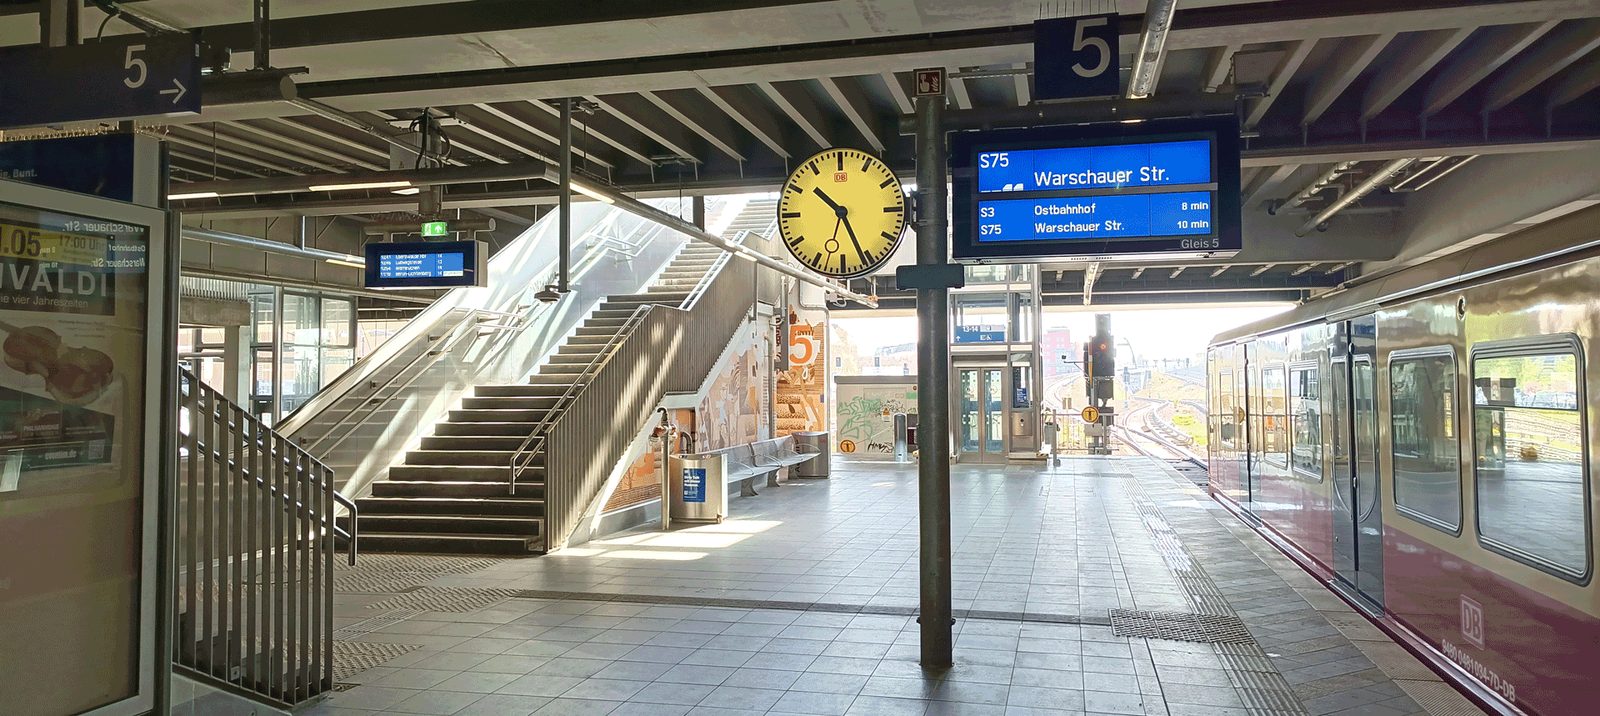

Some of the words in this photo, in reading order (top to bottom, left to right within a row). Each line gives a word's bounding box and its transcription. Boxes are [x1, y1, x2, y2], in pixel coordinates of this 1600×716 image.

[1071, 17, 1111, 78] 5
[123, 44, 148, 89] 5
[979, 152, 1010, 169] S75
[1034, 169, 1134, 187] Warschauer
[1139, 166, 1170, 183] Str.
[980, 207, 995, 218] S3
[1034, 203, 1096, 216] Ostbahnhof
[1181, 202, 1188, 211] 8
[1190, 201, 1209, 210] min
[980, 224, 1002, 235] S75
[1034, 221, 1101, 234] Warschauer
[1105, 220, 1125, 232] Str.
[1176, 220, 1188, 229] 10
[1190, 219, 1209, 229] min
[60, 234, 86, 248] 17:00
[1181, 238, 1209, 250] Gleis
[1212, 238, 1220, 248] 5
[12, 295, 31, 305] vier
[32, 295, 89, 308] Jahreszeiten
[789, 325, 812, 364] 5
[1463, 603, 1481, 641] DB
